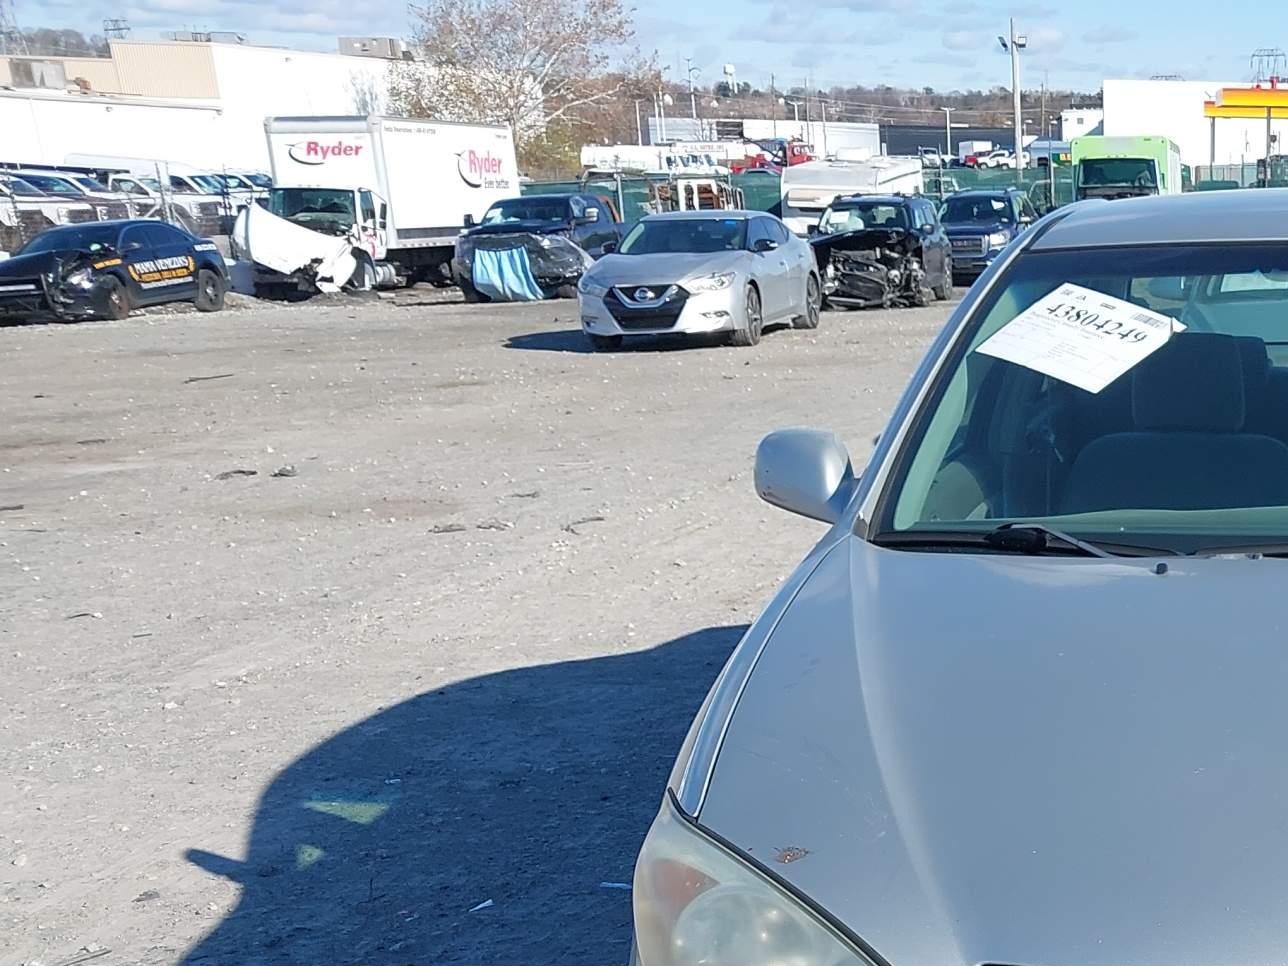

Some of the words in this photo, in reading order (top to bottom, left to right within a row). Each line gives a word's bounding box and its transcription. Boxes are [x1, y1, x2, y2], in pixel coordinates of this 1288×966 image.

[306, 141, 363, 160] Ryder
[468, 150, 502, 179] Ryder
[1045, 302, 1149, 344] 43804249
